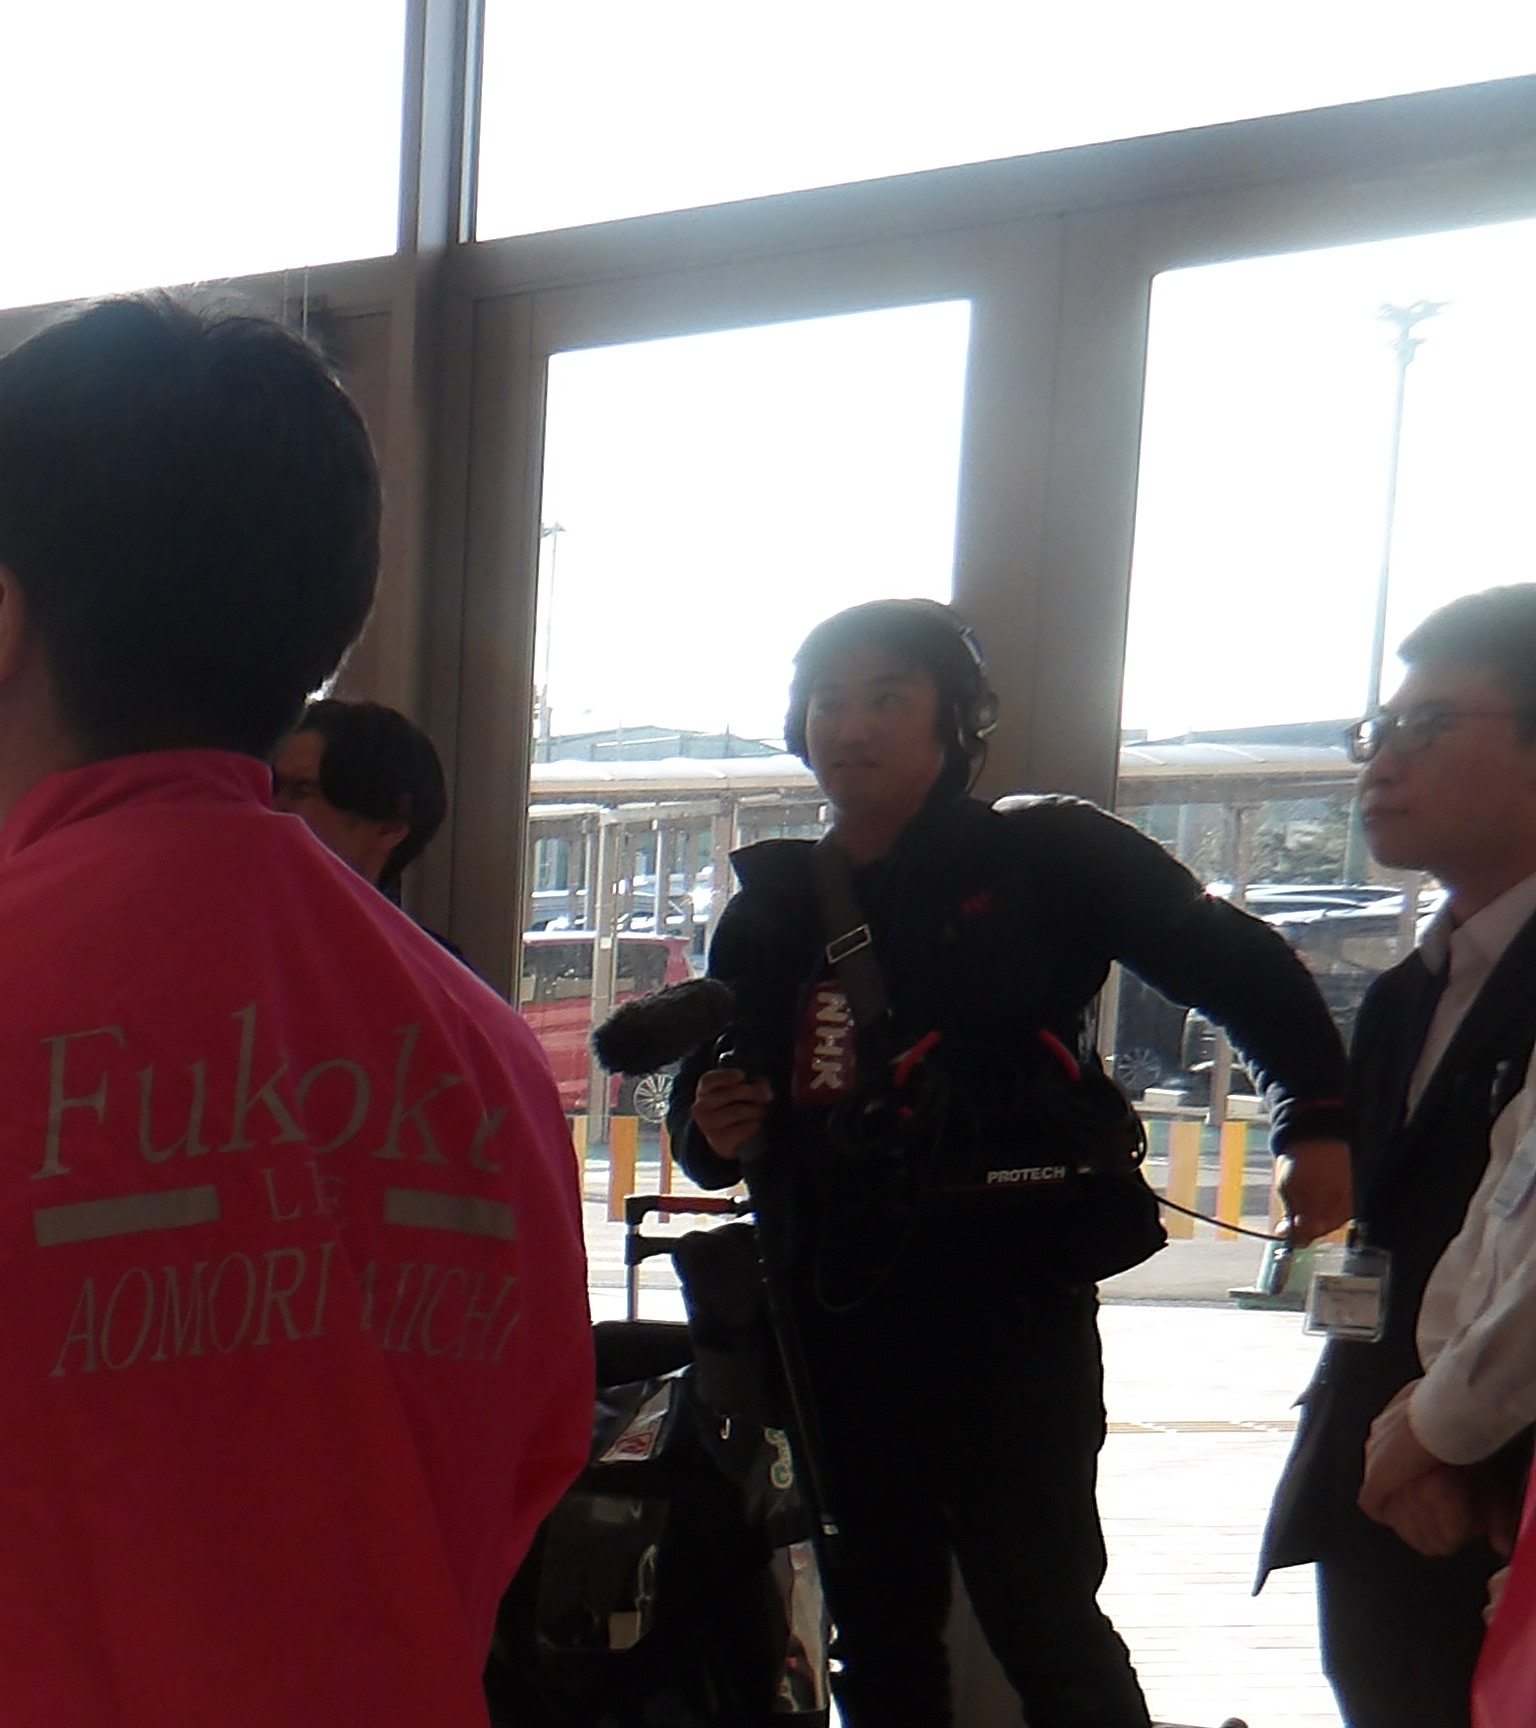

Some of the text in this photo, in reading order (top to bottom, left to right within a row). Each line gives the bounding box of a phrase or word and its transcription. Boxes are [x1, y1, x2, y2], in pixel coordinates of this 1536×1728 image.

[810, 991, 848, 1090] NHK
[987, 1166, 1066, 1184] PROTECH
[49, 1241, 337, 1378] AOMORI
